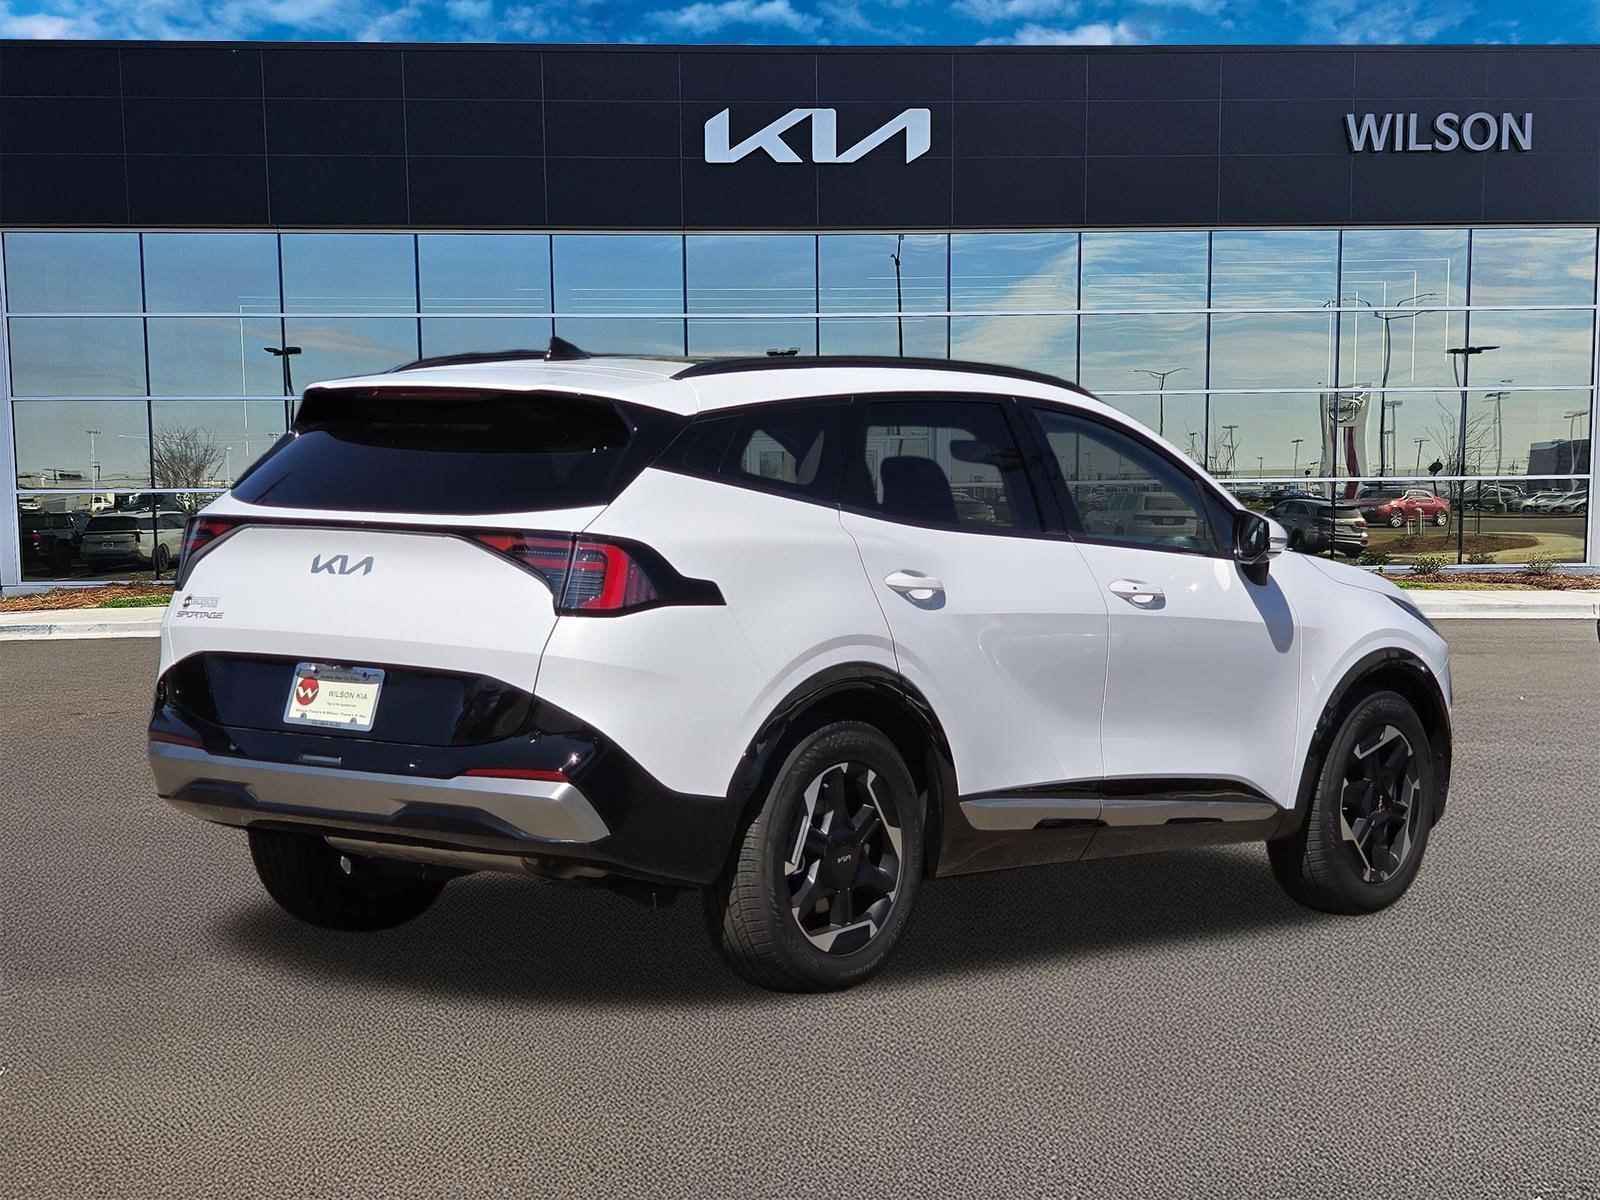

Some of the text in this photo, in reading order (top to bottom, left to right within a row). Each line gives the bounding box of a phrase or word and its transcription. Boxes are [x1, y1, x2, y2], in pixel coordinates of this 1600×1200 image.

[704, 107, 932, 164] KIA
[1345, 112, 1534, 152] WILSON
[310, 553, 374, 576] KIA
[176, 610, 225, 619] SPORTAGE
[328, 690, 368, 701] WILSON KIA
